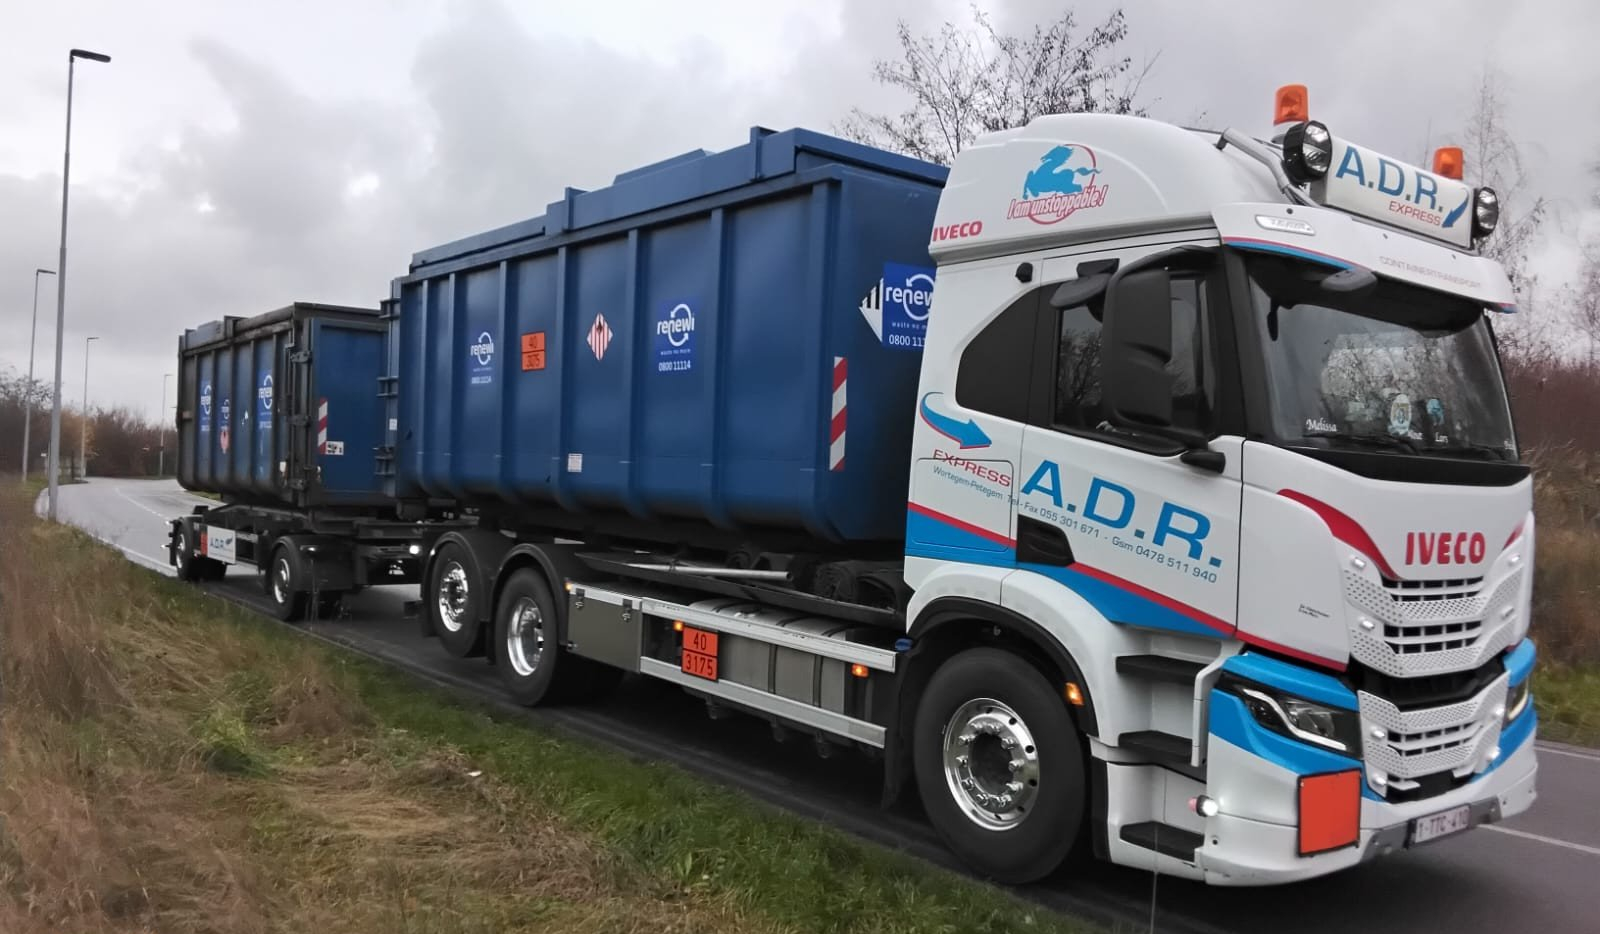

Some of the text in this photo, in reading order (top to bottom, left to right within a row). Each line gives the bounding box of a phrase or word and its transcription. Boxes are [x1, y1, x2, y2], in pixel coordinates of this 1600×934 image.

[1336, 145, 1444, 213] A.D.R.
[1013, 199, 1031, 219] am
[1389, 200, 1441, 226] EXPRESS
[932, 220, 983, 242] IVECO
[657, 314, 695, 336] renewi
[888, 334, 911, 346] 0800
[932, 449, 1011, 488] EXPRESS
[933, 465, 1004, 501] Wortegem-Petegem
[1024, 502, 1039, 514] Fax
[1039, 508, 1058, 522] 055
[1060, 515, 1079, 530] 301
[1080, 523, 1100, 538] 671
[1111, 536, 1134, 552] Gsm
[1135, 545, 1165, 564] 0478
[1167, 557, 1190, 574] 511
[1192, 567, 1218, 584] 940
[1020, 459, 1222, 568] A.D.R.
[1404, 531, 1486, 566] IVECO
[693, 631, 707, 650] 40
[685, 653, 714, 677] 3175
